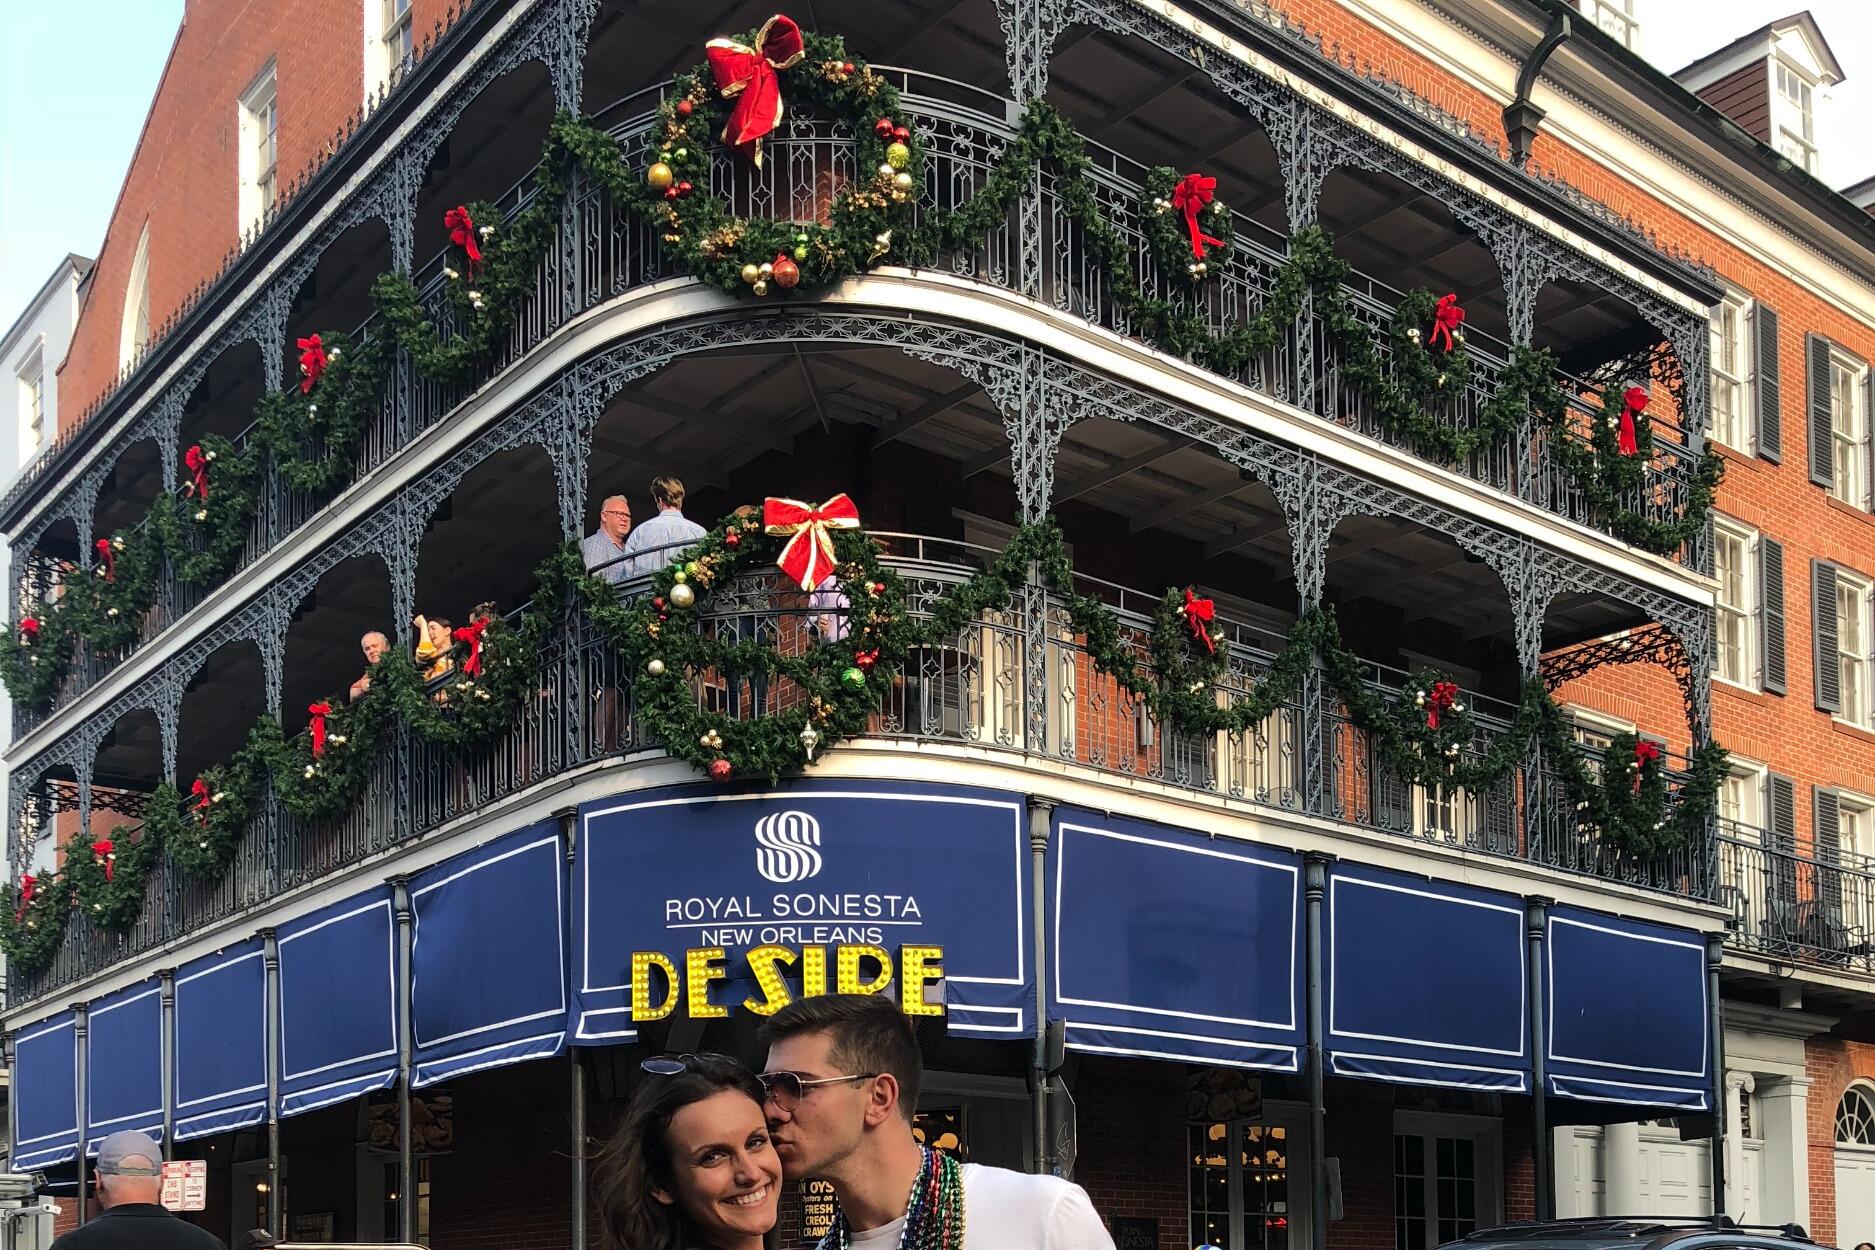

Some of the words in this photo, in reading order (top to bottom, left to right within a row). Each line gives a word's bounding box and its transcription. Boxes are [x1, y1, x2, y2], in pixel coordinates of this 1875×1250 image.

[665, 896, 762, 921] ROYAL
[772, 894, 923, 918] SONESTA
[701, 928, 753, 946] NEW
[760, 926, 884, 944] ORLEANS
[631, 943, 948, 1021] DESIRE
[805, 1204, 834, 1214] FRESH
